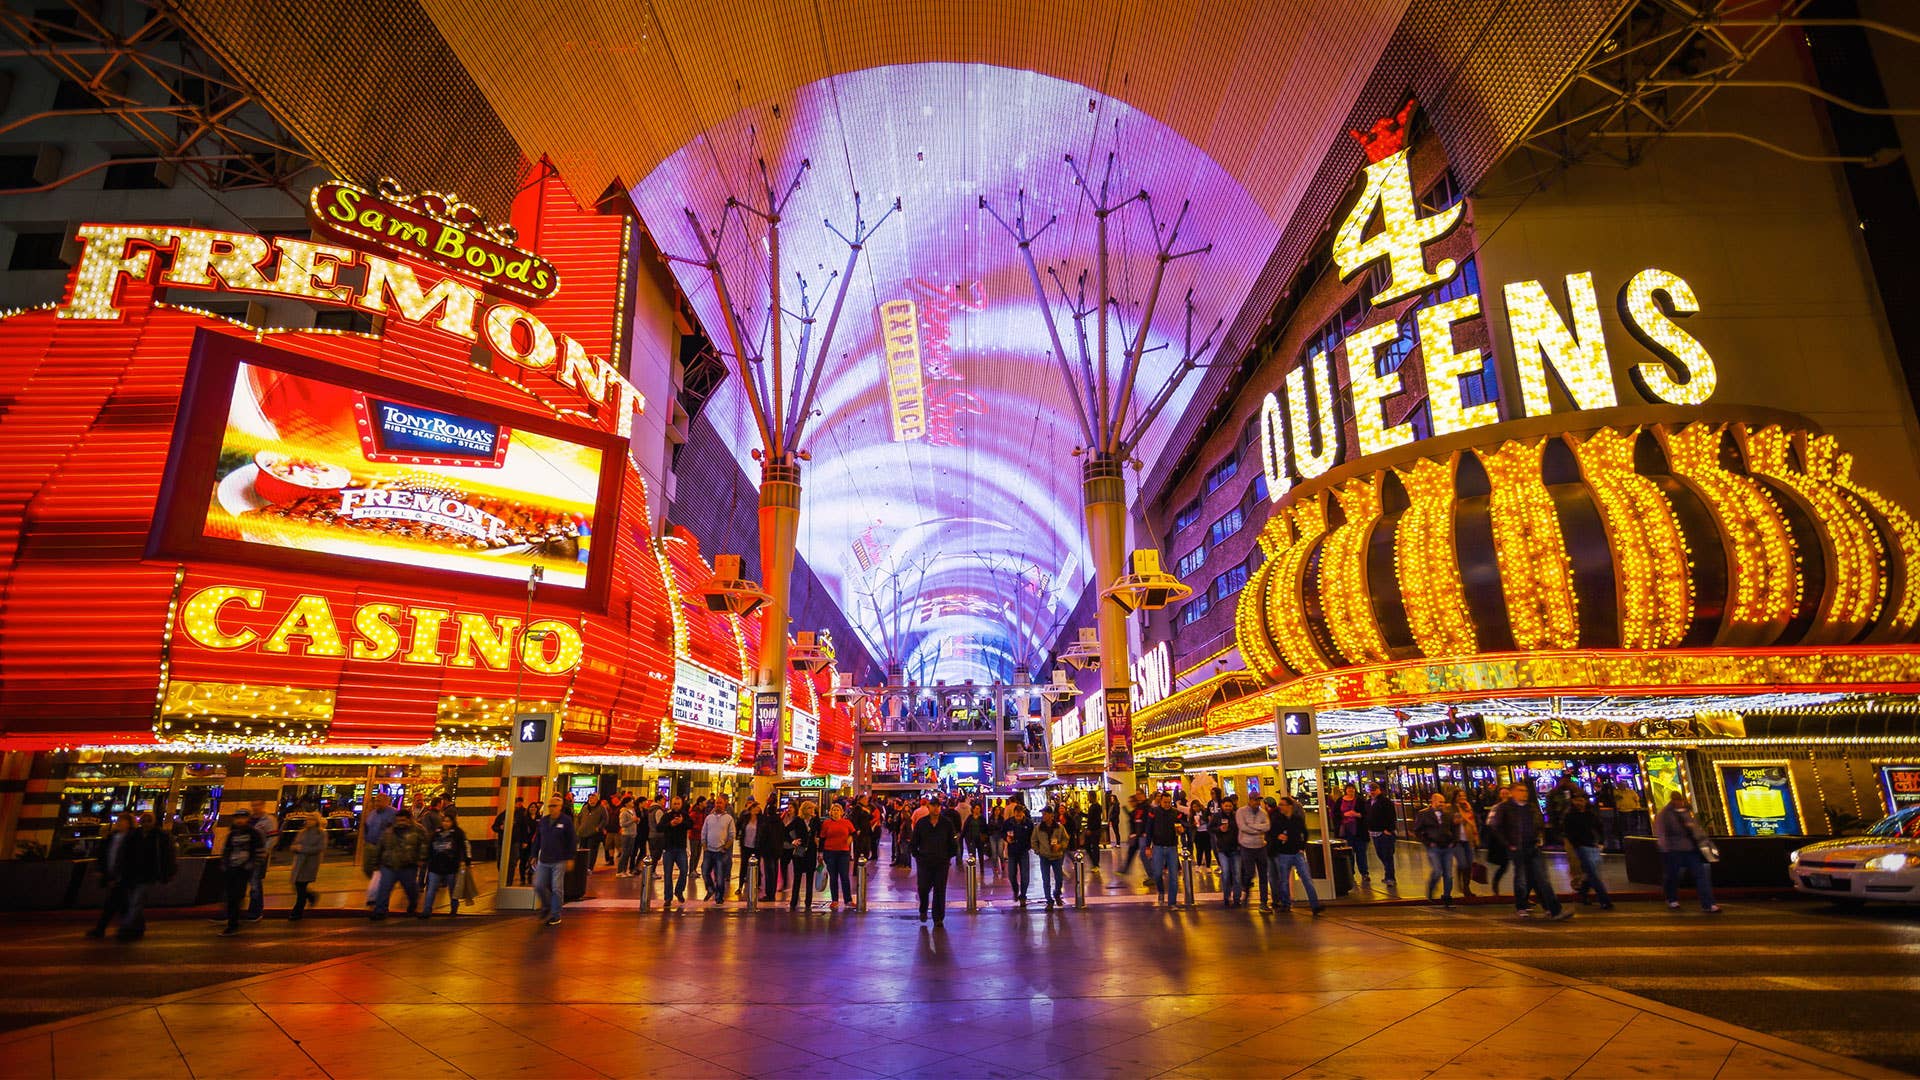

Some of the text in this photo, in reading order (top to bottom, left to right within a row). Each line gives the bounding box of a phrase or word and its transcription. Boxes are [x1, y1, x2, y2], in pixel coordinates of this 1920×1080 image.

[328, 187, 549, 290] Sam Boyd's
[1333, 146, 1464, 306] 4
[56, 222, 646, 438] FREMONT
[886, 303, 921, 438] EXPERIENCE
[1260, 268, 1718, 504] QUEENS
[384, 423, 490, 453] RIBS SEAFOOD STEAKS
[337, 488, 507, 542] FREMONT
[362, 509, 408, 518] HOTEL
[180, 585, 583, 675] CASINO
[1130, 641, 1171, 714] ASINO
[758, 708, 777, 720] JOIN
[760, 719, 774, 728] THE
[1106, 703, 1129, 717] FLY
[1110, 716, 1127, 725] THE
[304, 766, 347, 776] BUFFET
[800, 778, 825, 787] CIGARS
